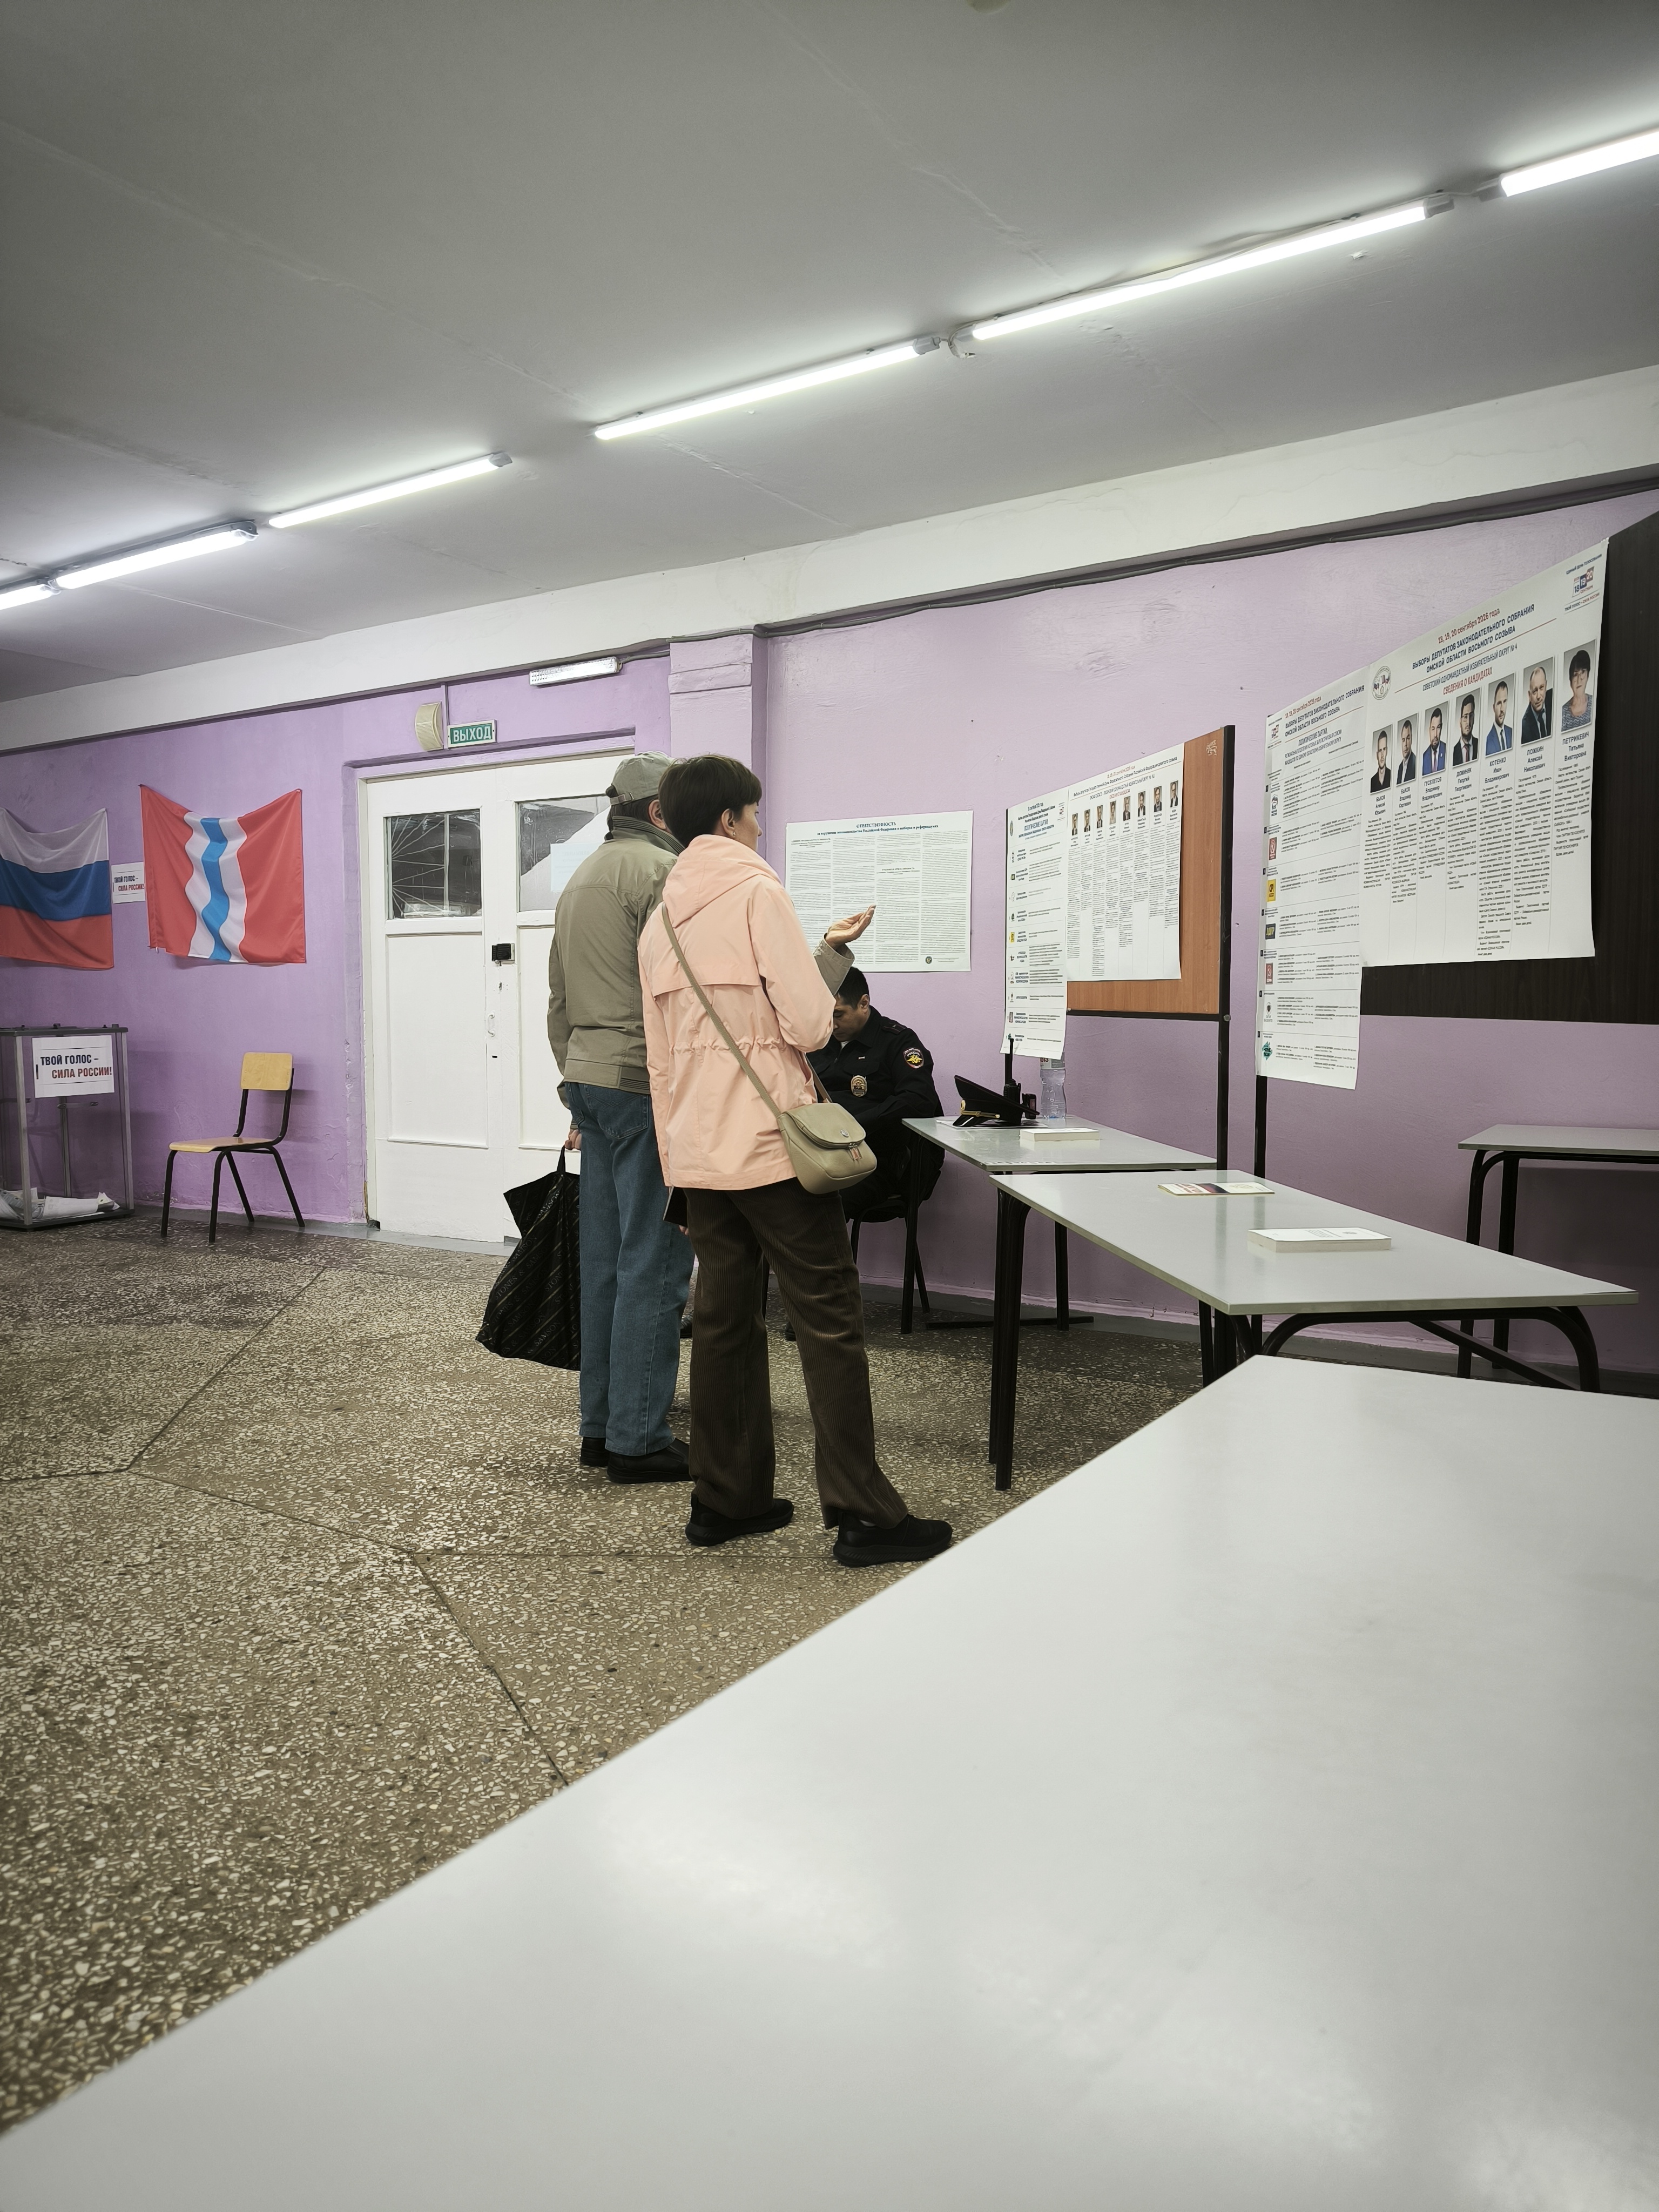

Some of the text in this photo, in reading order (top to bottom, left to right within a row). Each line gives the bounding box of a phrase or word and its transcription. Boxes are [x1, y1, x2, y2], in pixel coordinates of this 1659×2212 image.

[1580, 577, 1586, 586] 19
[1586, 570, 1593, 580] 20
[1574, 584, 1580, 593] 18
[1457, 618, 1478, 635] сентября
[1477, 613, 1489, 625] 2026
[1489, 608, 1500, 620] года
[1412, 604, 1535, 670] ВЫБОРЫ ДЕПУТАТОВ ЗАКОНОДАТЕЛЬНОГО СОБРАНИЯ
[1426, 625, 1516, 674] ОМСКОЙ ОБЛАСТИ ВОСЬМОГО СОЗЫВА
[1422, 675, 1441, 692] СОВЕТСКИЙ
[1469, 652, 1499, 675] ИЗБИРАТЕЛЬНЫЙ
[1498, 647, 1510, 658] ОКРУГ
[1443, 666, 1493, 696] СВЕДЕНИЯ О КАНДИДАТАХ
[1285, 685, 1365, 729] ВЫБОРЫ ДЕПУТАТОВ ЗАКОНОДАТЕЛЬНОГО СОБРАНИЯ
[1285, 706, 1340, 737] ОМСКОЙ ОБЛАСТИ ВОСЬМОГО СОЗЫВА
[453, 726, 491, 743] ВЫХОД
[1562, 731, 1589, 745] ПЕТРИКЕВИЧ
[1527, 746, 1544, 756] ЛОЖКИН
[1568, 743, 1584, 752] Татьяна
[1489, 757, 1507, 766] КОТЕНКО
[1527, 754, 1543, 764] Алексей
[1564, 750, 1587, 761] Викторовна
[1523, 763, 1546, 773] Николаевич
[40, 1055, 62, 1066] ТВОЙ
[65, 1054, 92, 1064] ГОЛОС
[51, 1067, 112, 1079] СИЛА РОССИИ!
[495, 1275, 518, 1300] STONES
[534, 1320, 560, 1346] SAMSON
